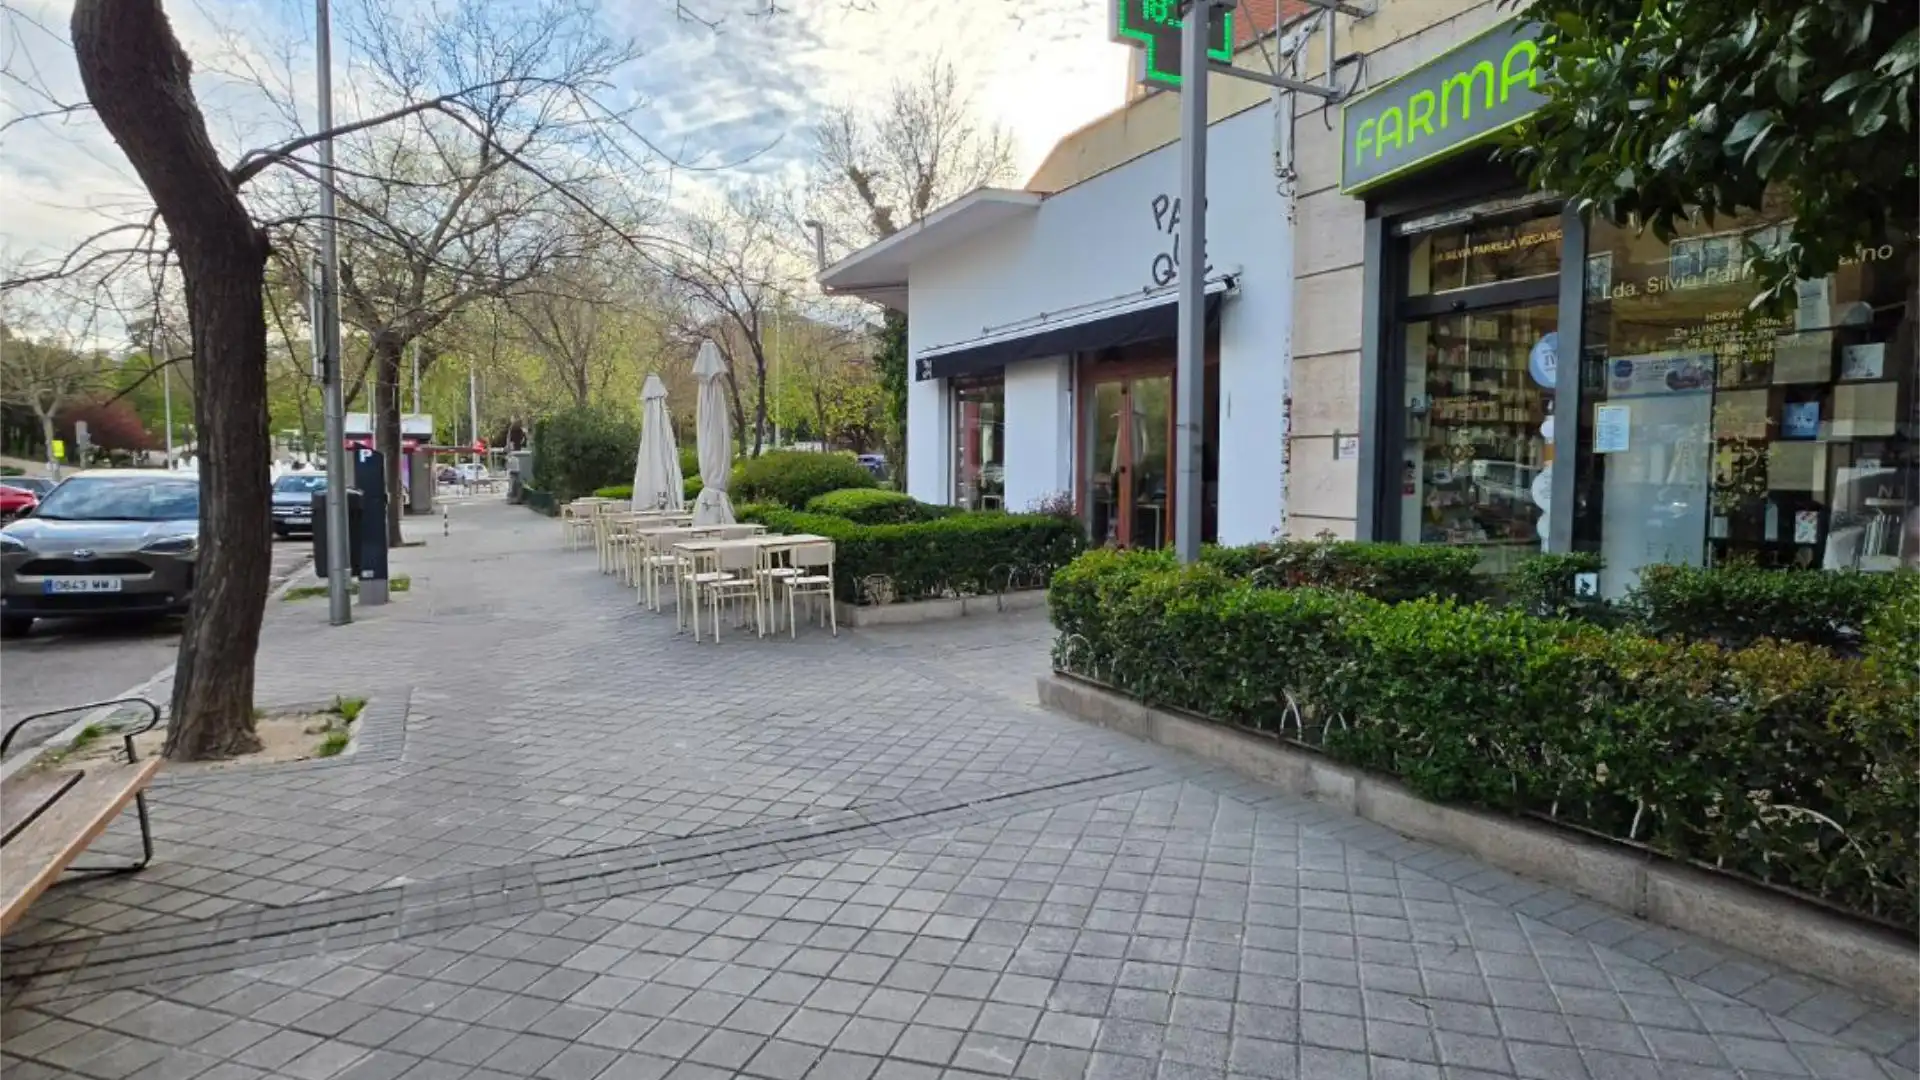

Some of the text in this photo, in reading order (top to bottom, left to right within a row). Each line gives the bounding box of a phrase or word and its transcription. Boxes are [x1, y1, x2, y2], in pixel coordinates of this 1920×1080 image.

[1602, 281, 1640, 300] Lda.
[1647, 273, 1697, 293] Silvia
[359, 449, 373, 463] P
